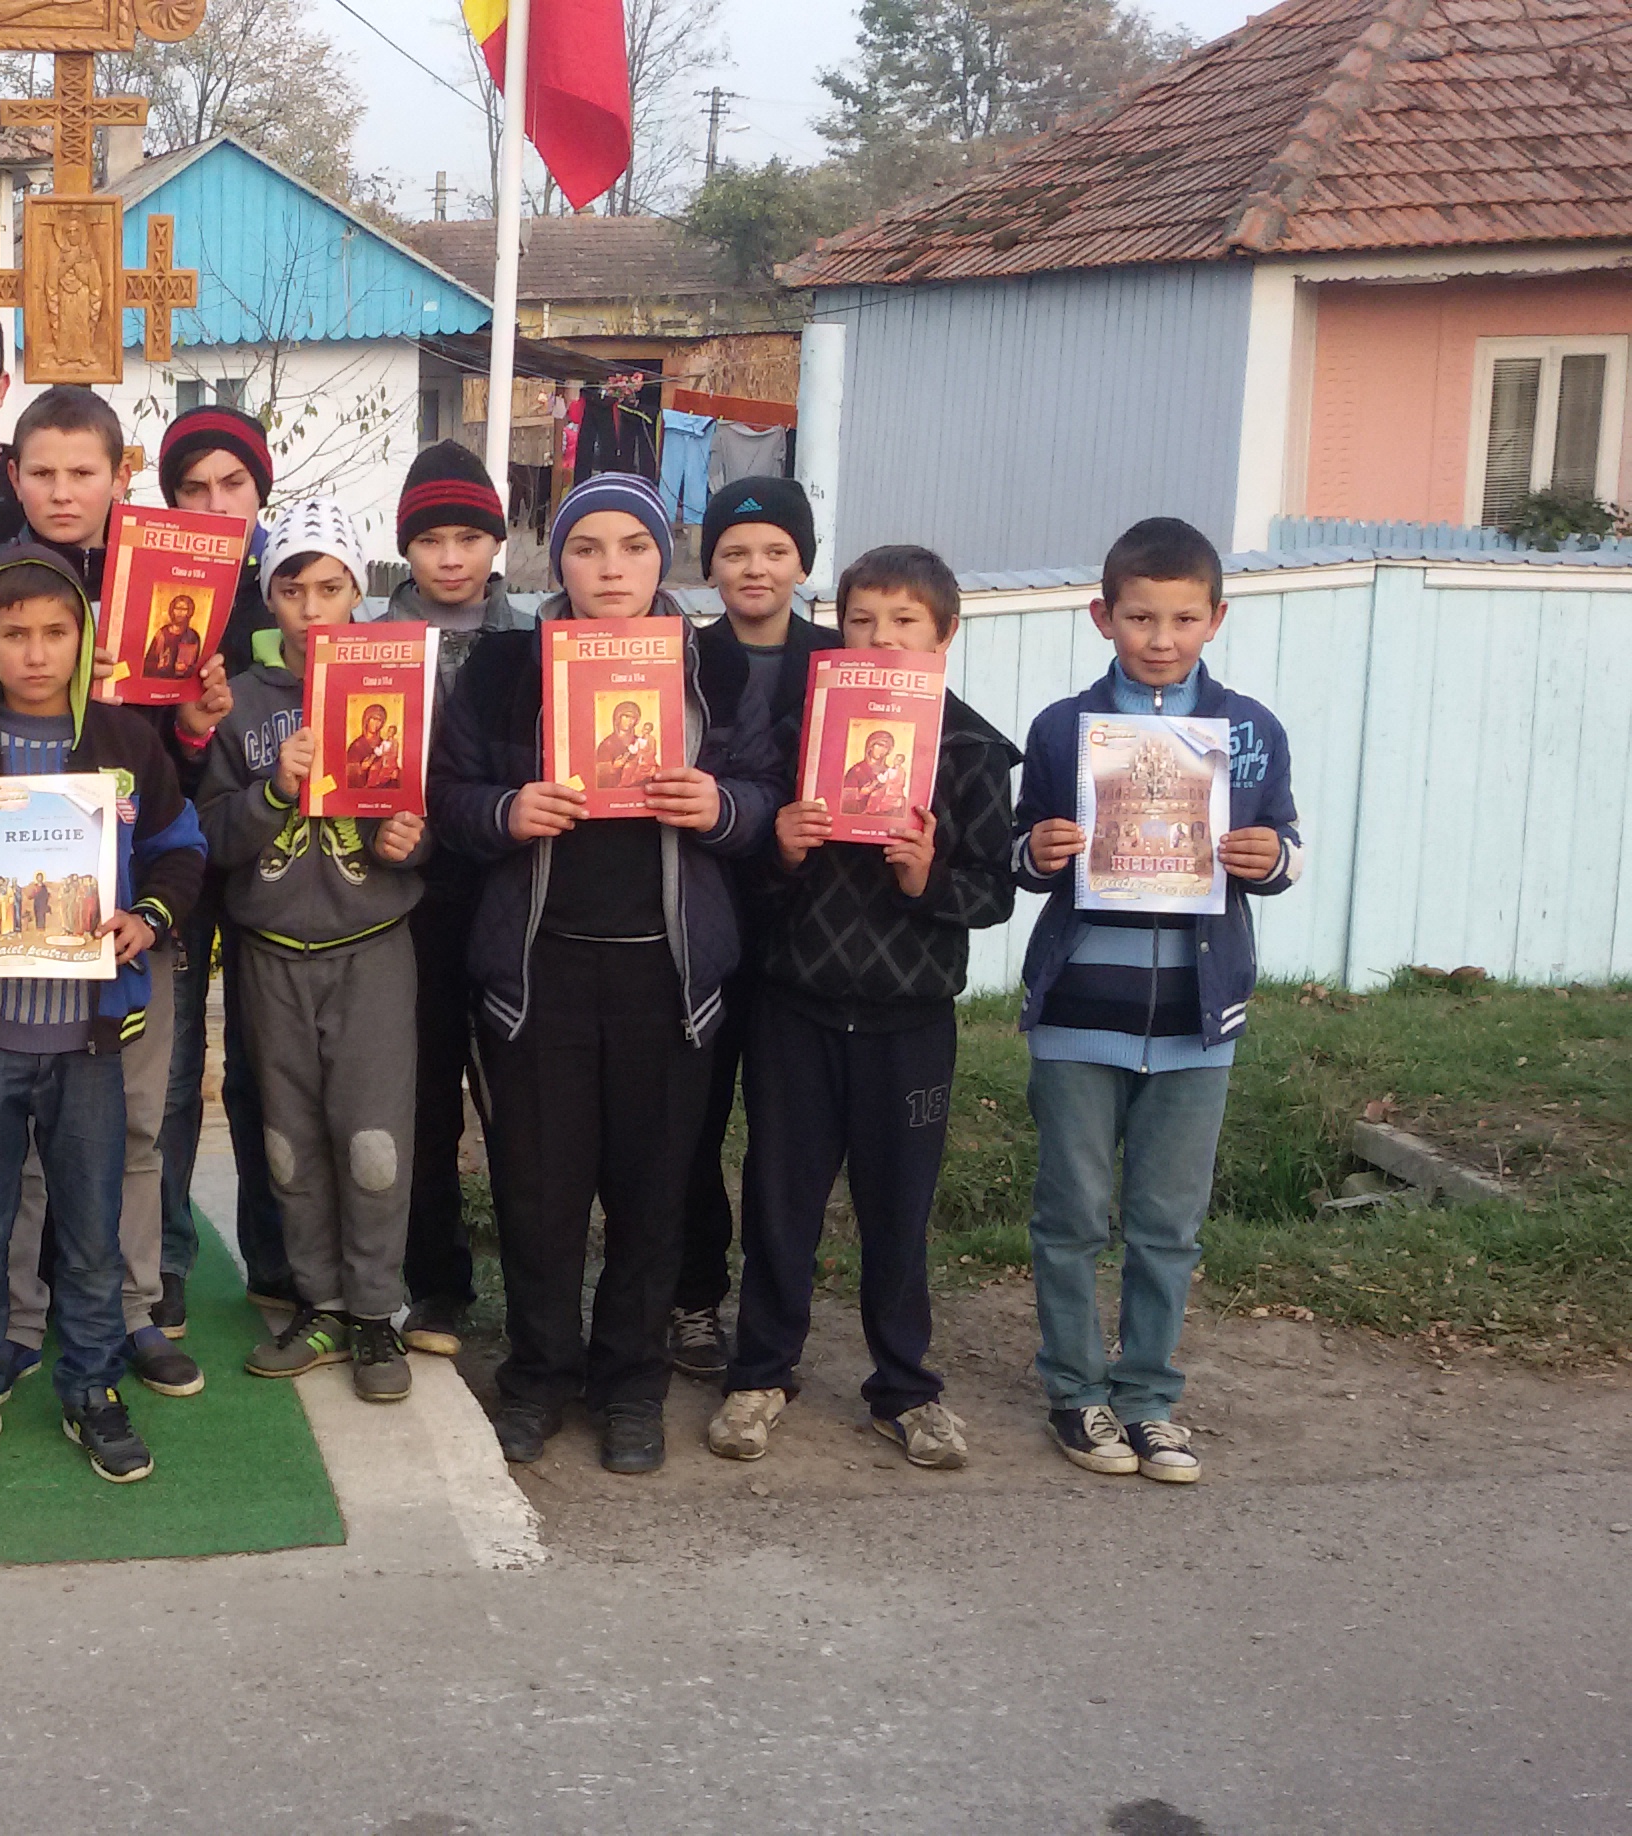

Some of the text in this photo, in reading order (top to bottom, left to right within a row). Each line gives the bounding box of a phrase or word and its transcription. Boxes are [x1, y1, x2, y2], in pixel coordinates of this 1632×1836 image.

[144, 531, 228, 555] RELIGIE
[337, 644, 412, 661] RELIGIE
[578, 640, 666, 657] RELIGIE
[839, 671, 927, 689] RELIGIE
[5, 829, 85, 843] RELIGIE
[1112, 857, 1195, 871] RELIGIE
[905, 1084, 948, 1128] 18
